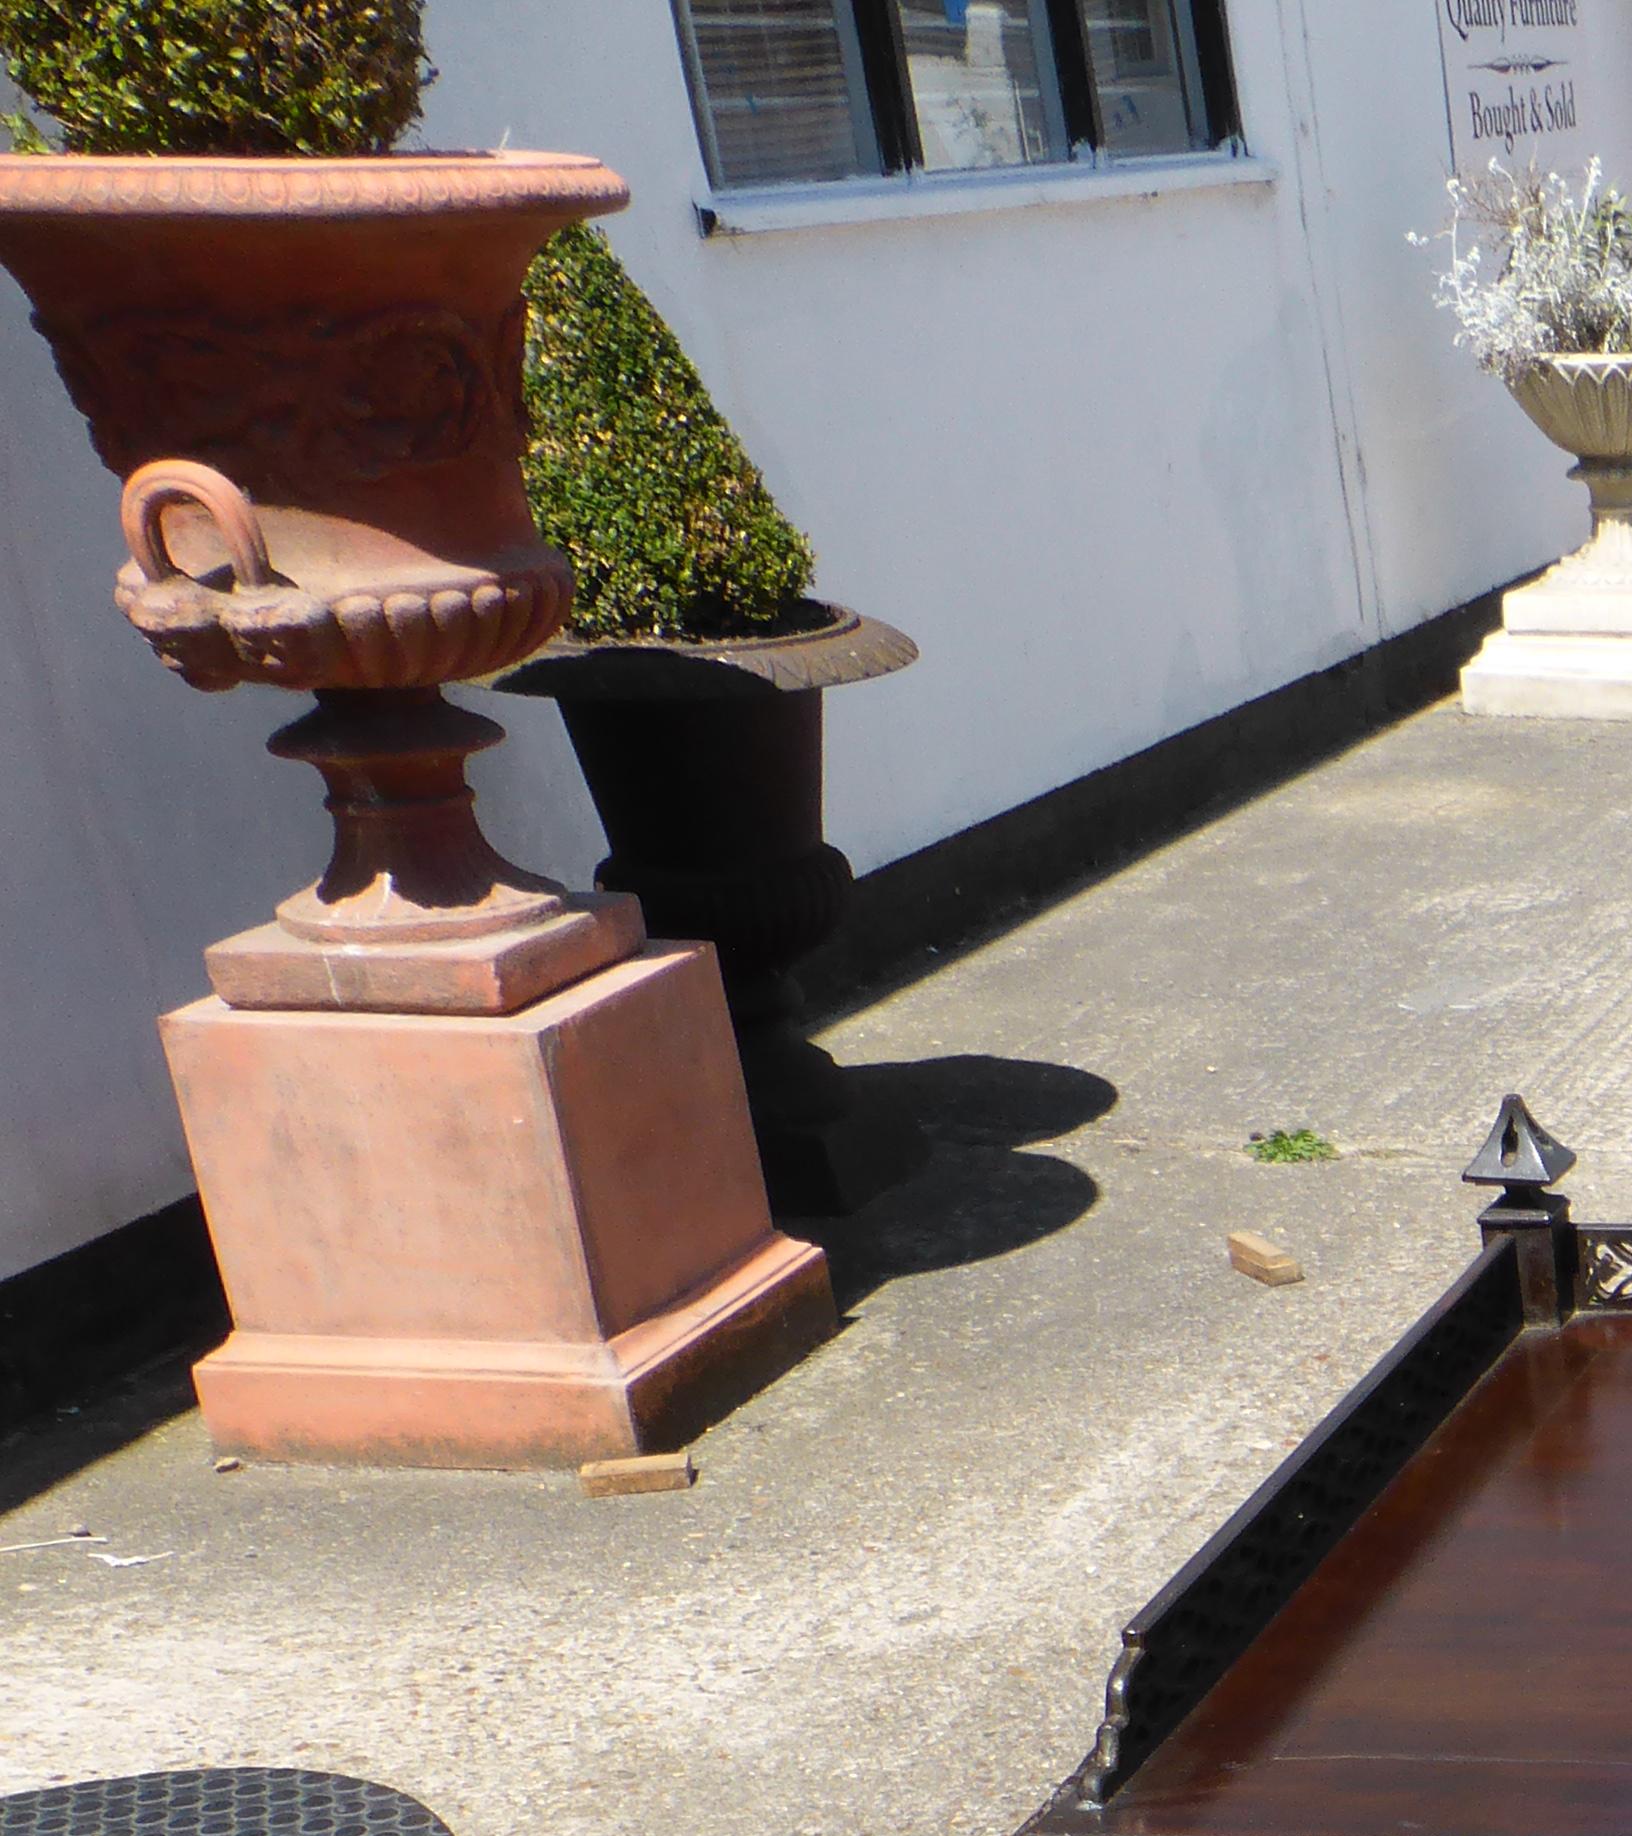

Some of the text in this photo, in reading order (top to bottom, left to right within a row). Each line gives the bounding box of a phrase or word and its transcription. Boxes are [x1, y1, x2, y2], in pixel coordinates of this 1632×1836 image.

[1468, 80, 1577, 156] Bought & Sold
